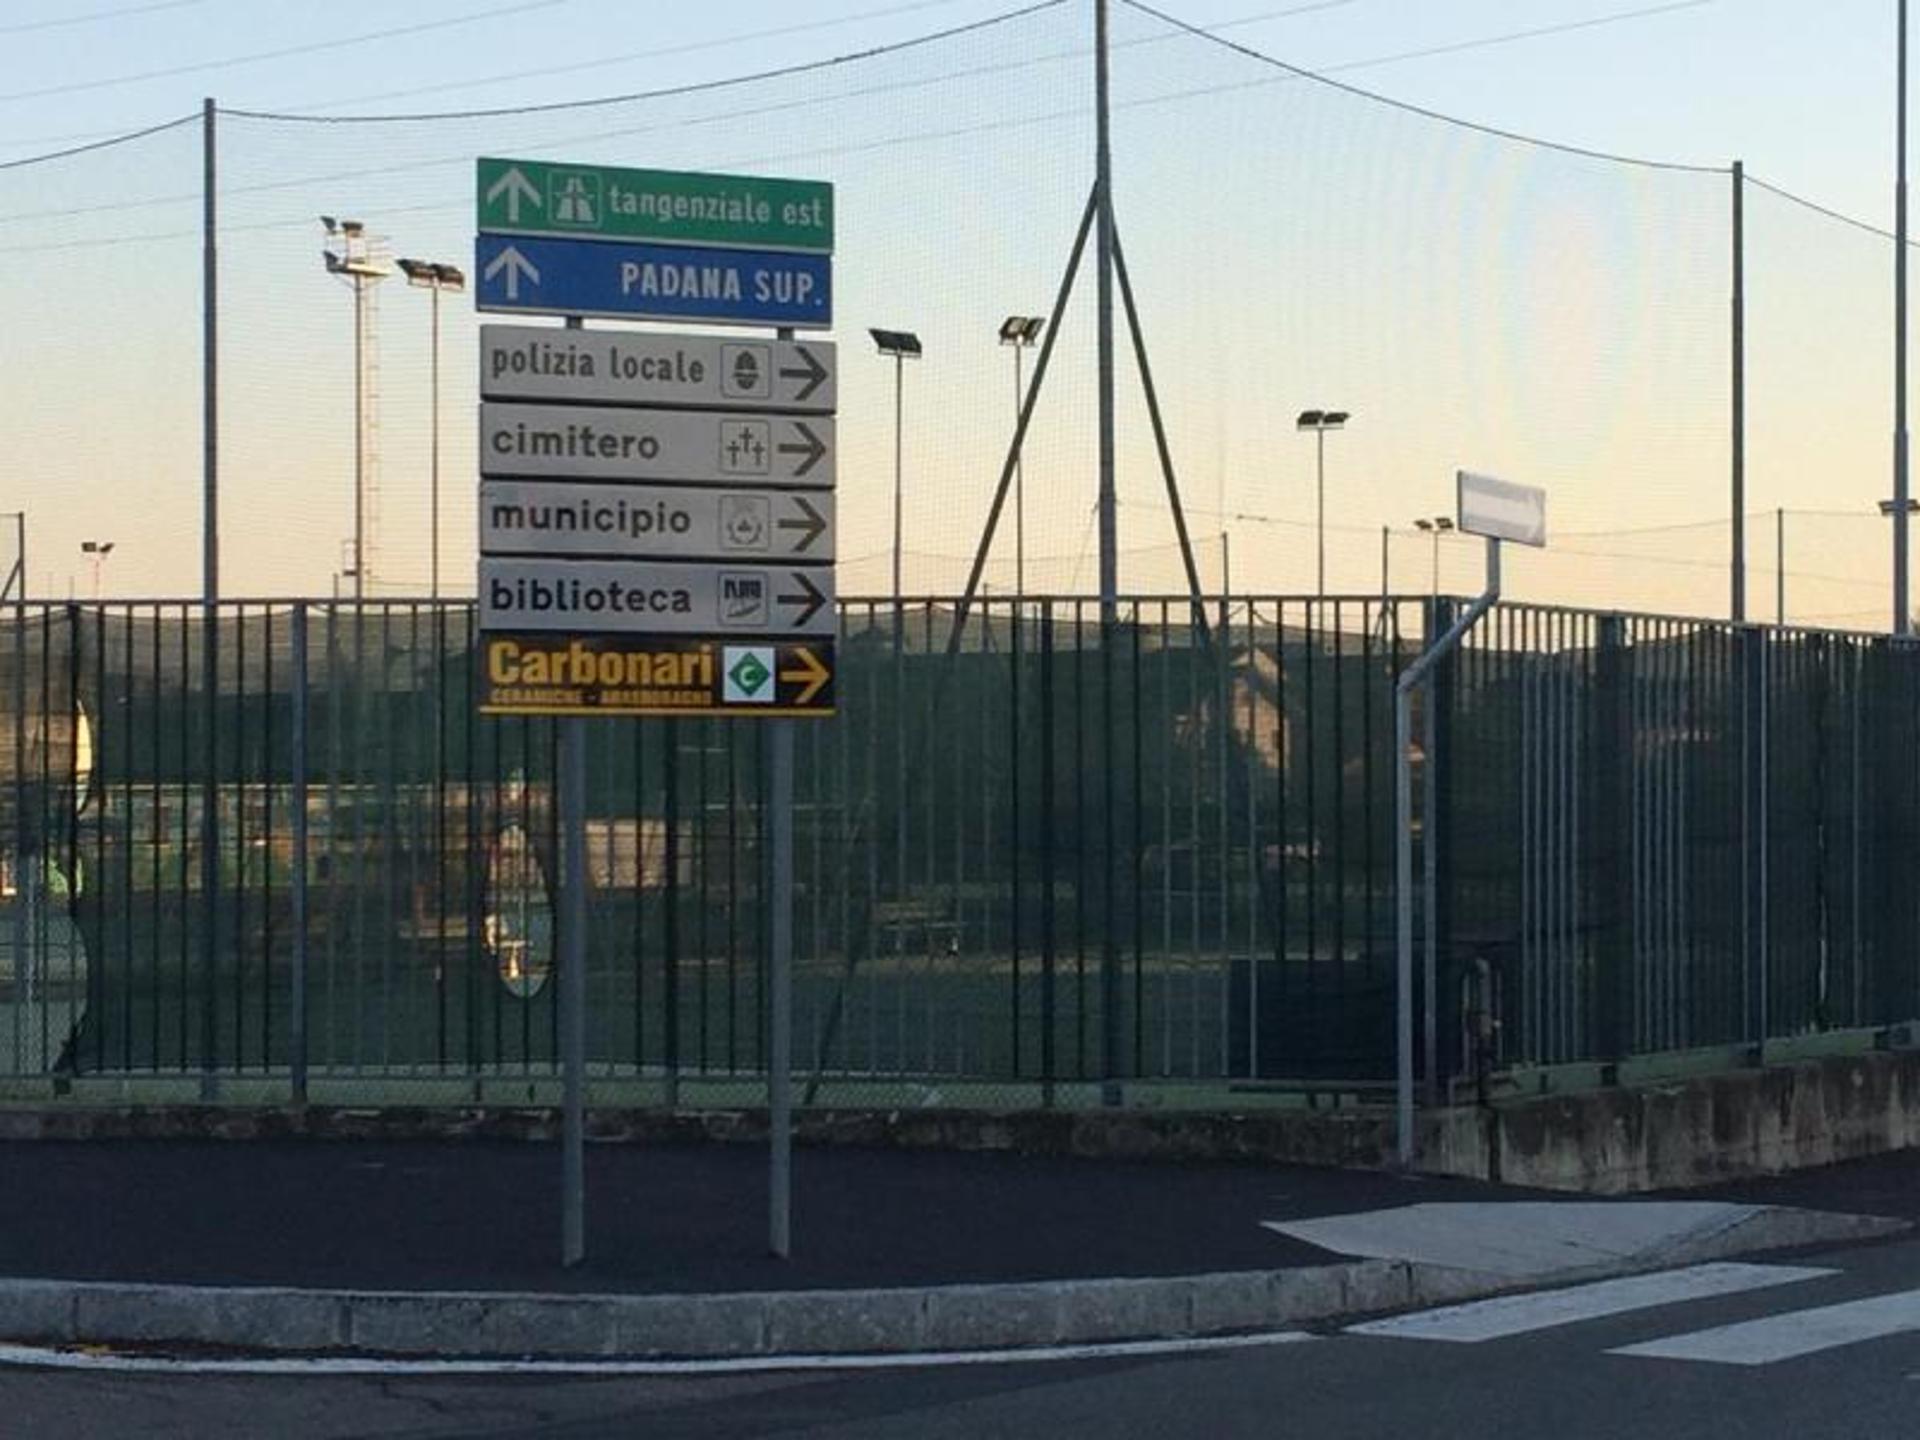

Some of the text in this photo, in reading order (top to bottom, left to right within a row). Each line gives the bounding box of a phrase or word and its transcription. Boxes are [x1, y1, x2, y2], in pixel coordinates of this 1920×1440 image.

[610, 184, 824, 227] tangenziale est
[621, 262, 823, 306] PADANA SUP.
[492, 342, 704, 383] polizia locale
[492, 424, 660, 459] cimitero
[491, 500, 691, 538] municipio
[490, 579, 692, 613] biblioteca
[489, 640, 712, 686] Carbonari
